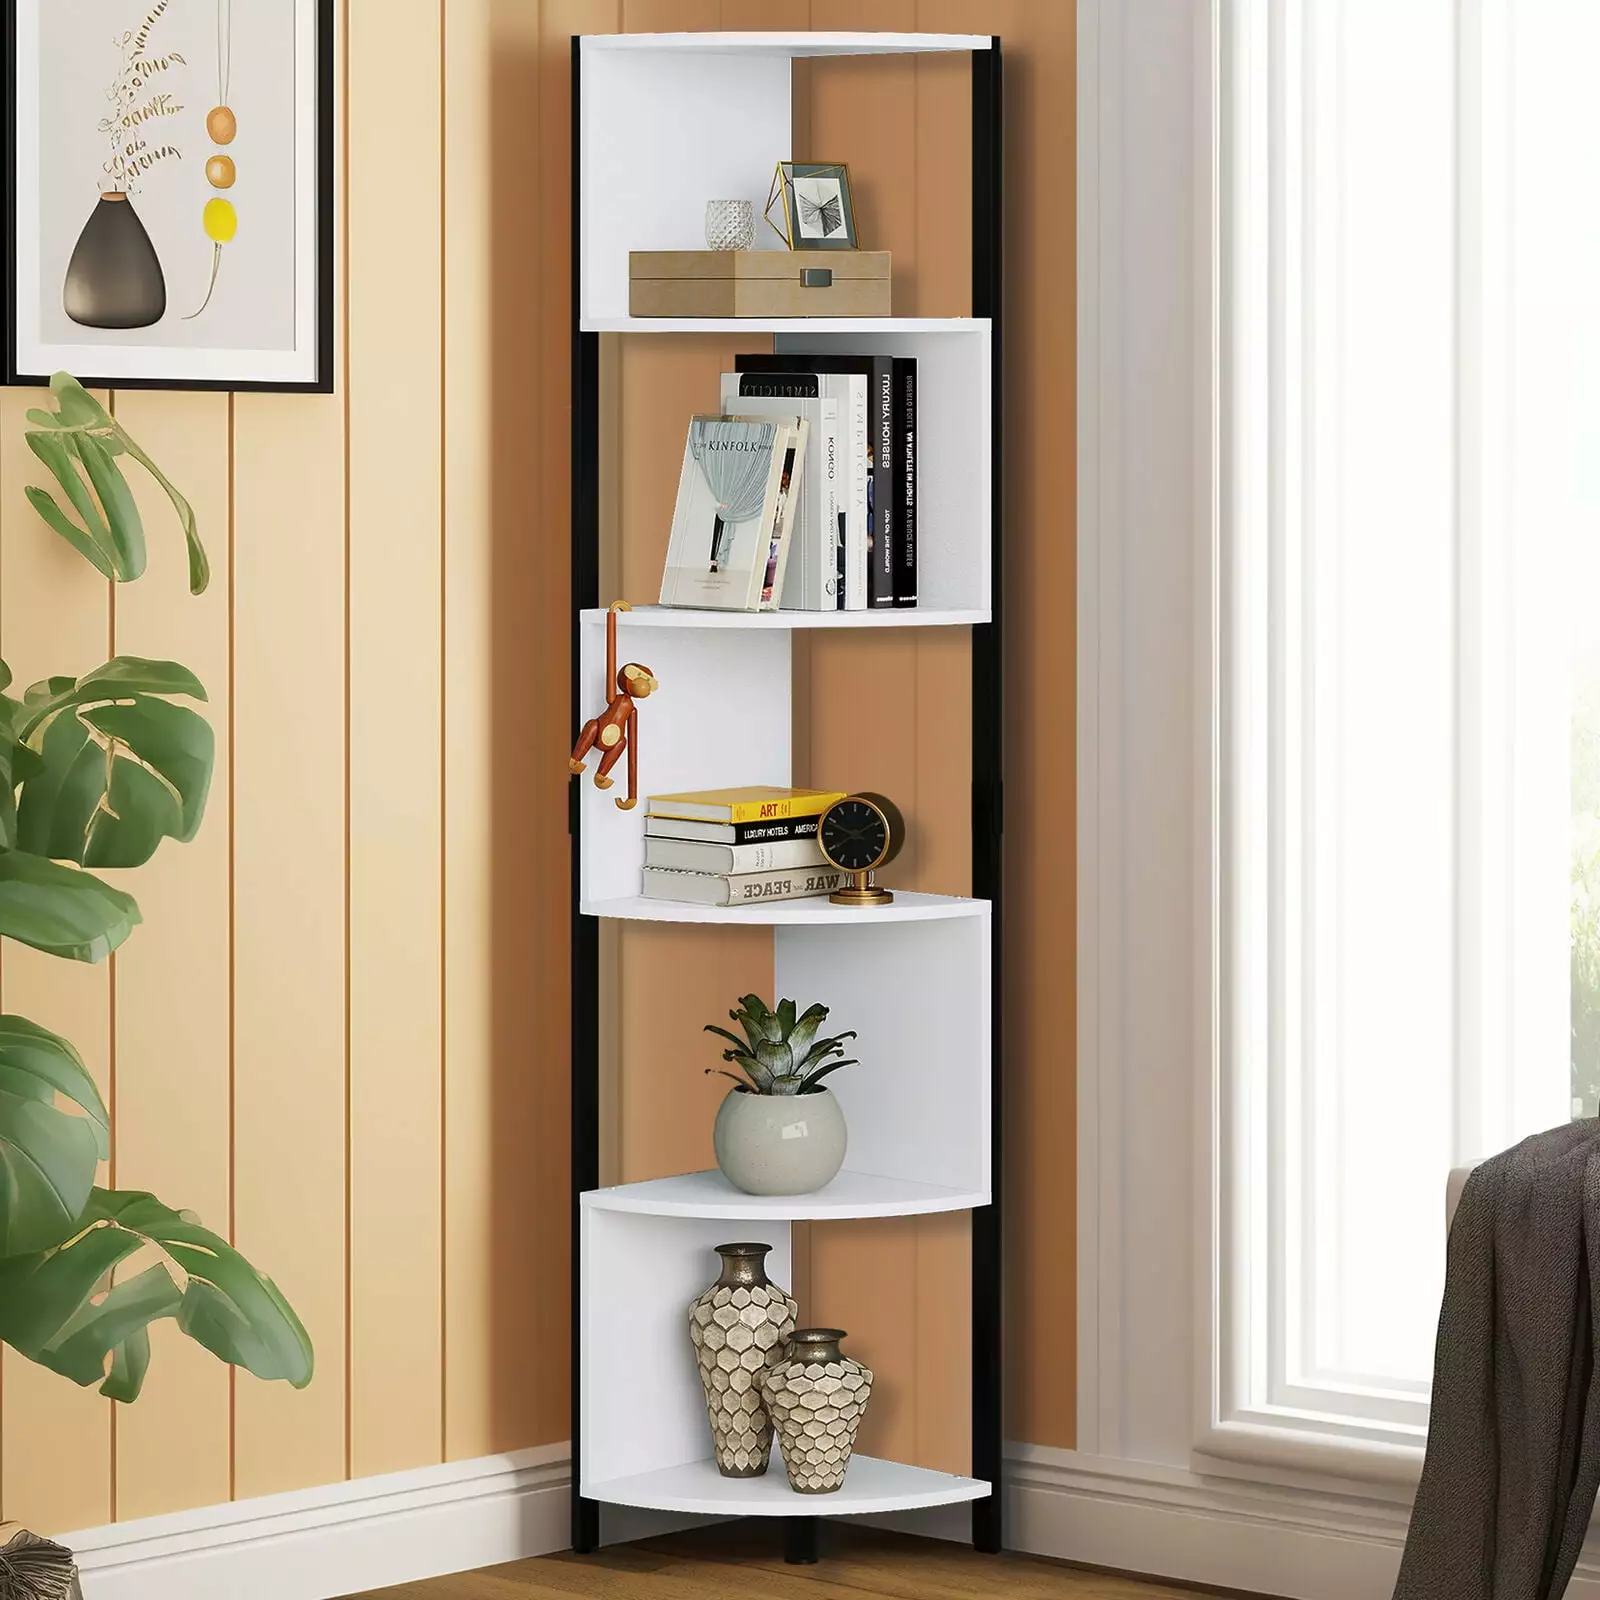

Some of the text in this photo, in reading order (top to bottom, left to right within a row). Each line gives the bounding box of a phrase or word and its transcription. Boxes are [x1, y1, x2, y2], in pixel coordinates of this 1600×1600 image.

[708, 440, 758, 453] KINFOLK
[759, 803, 778, 818] ART
[744, 829, 766, 839] LUXURY
[766, 826, 789, 837] HOTELS
